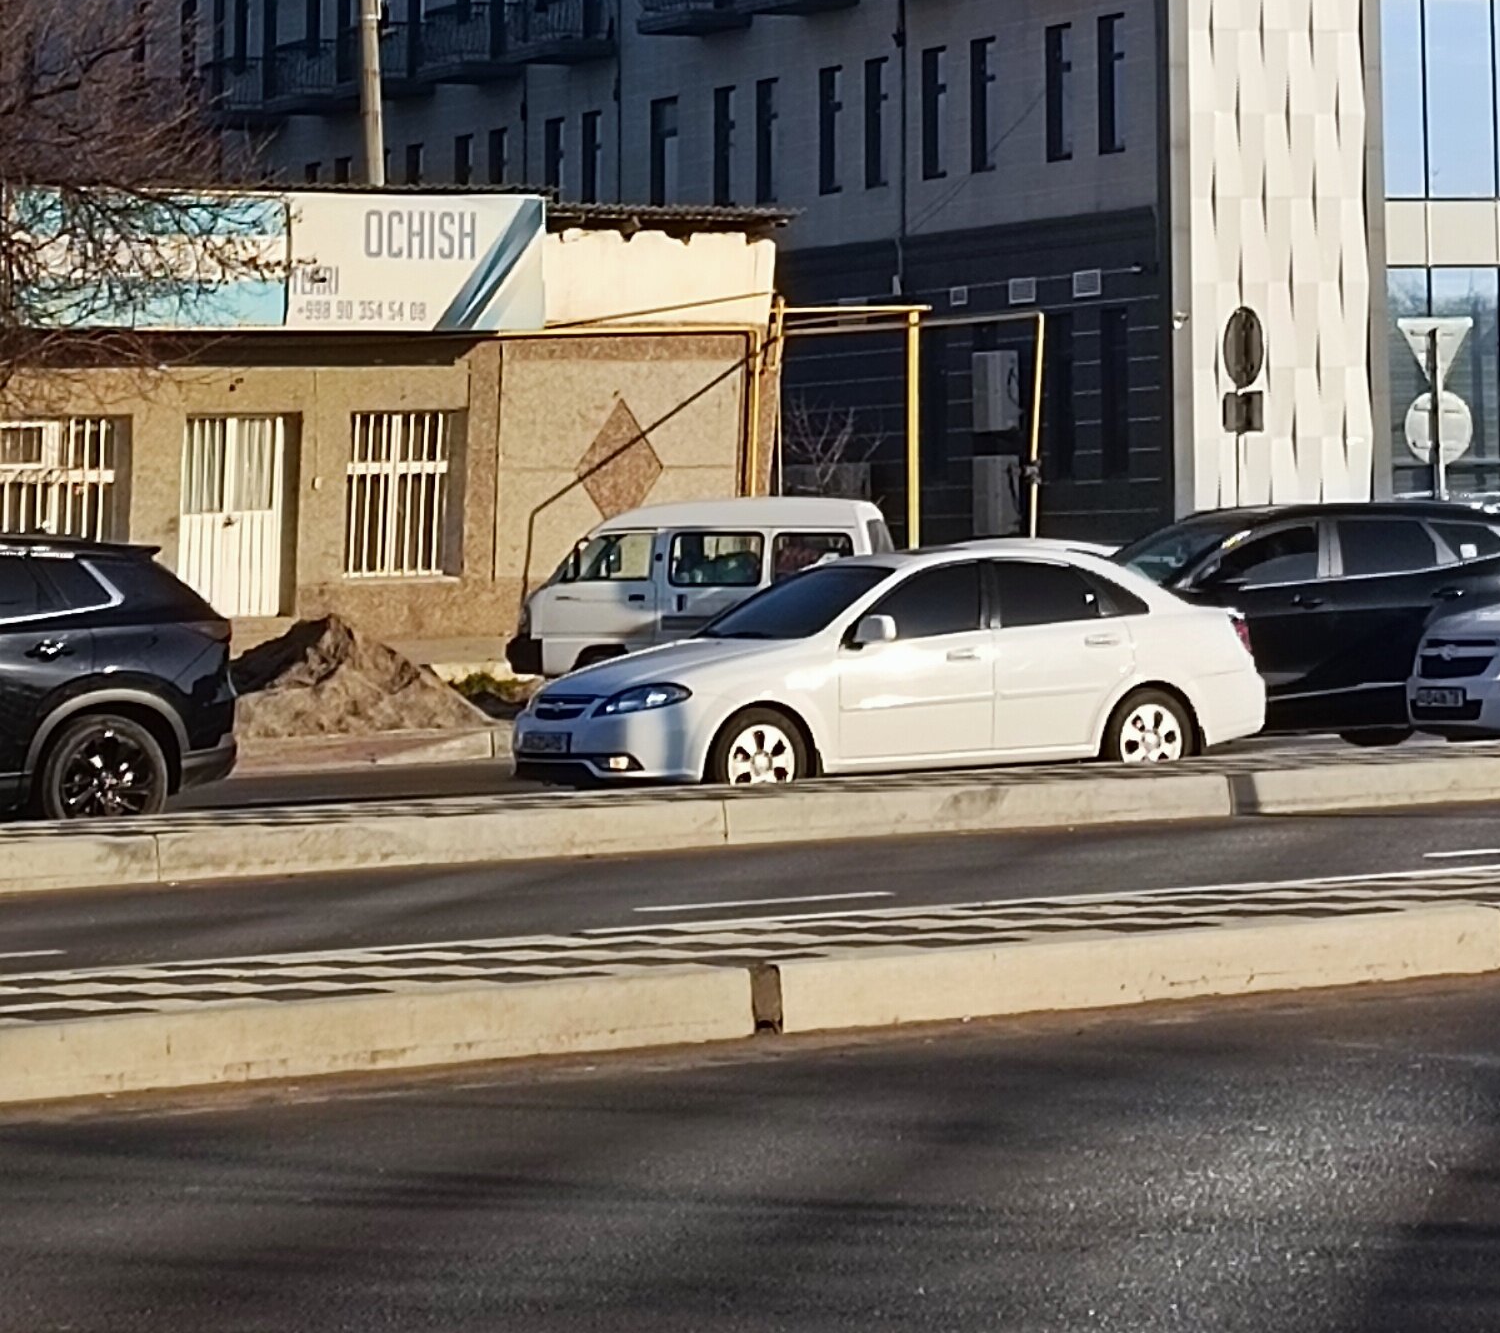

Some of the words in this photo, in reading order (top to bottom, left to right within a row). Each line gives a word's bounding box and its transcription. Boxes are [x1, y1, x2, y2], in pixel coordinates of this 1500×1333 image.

[364, 209, 477, 260] OCHISH
[296, 300, 331, 320] +998
[336, 300, 353, 320] 90
[358, 300, 383, 321] 354
[387, 301, 404, 321] 54
